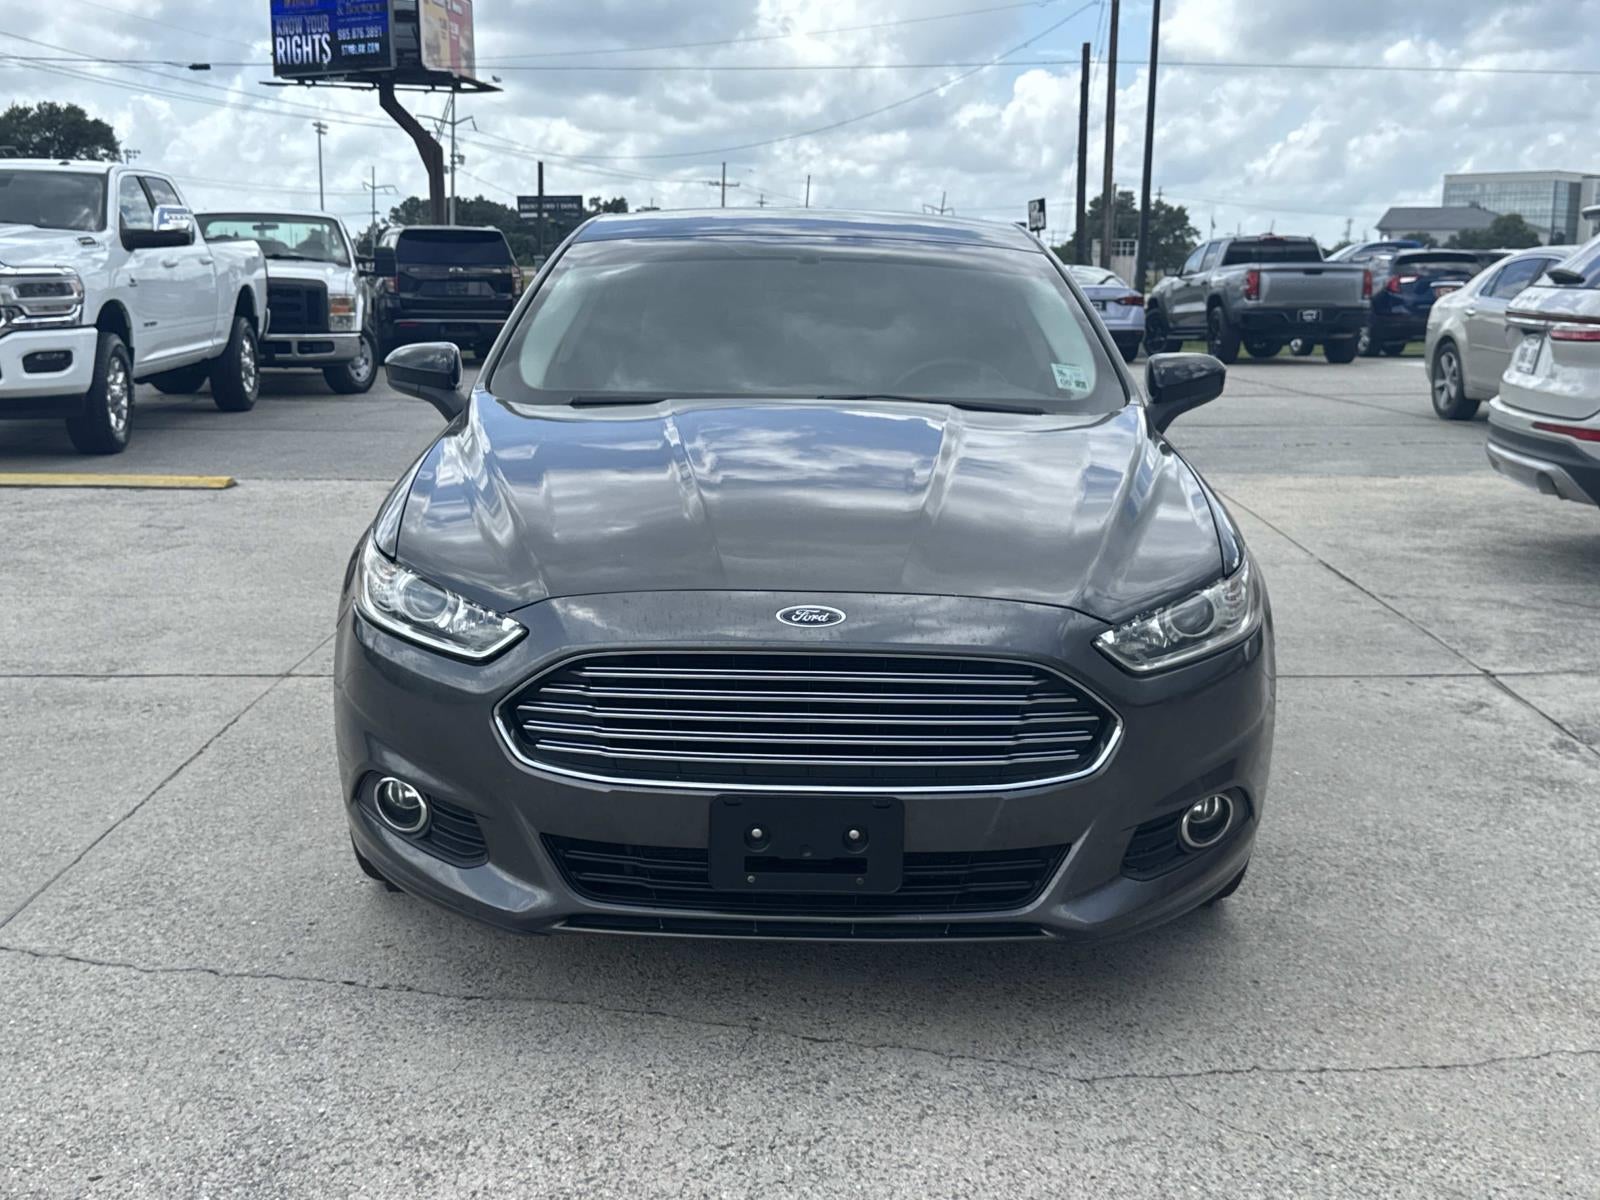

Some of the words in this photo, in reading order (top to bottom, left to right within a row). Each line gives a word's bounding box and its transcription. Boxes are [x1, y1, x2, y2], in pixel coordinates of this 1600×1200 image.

[276, 16, 303, 35] KNOW
[304, 14, 330, 33] YOUR
[276, 33, 332, 65] RIGHTS
[791, 609, 830, 622] Ford
